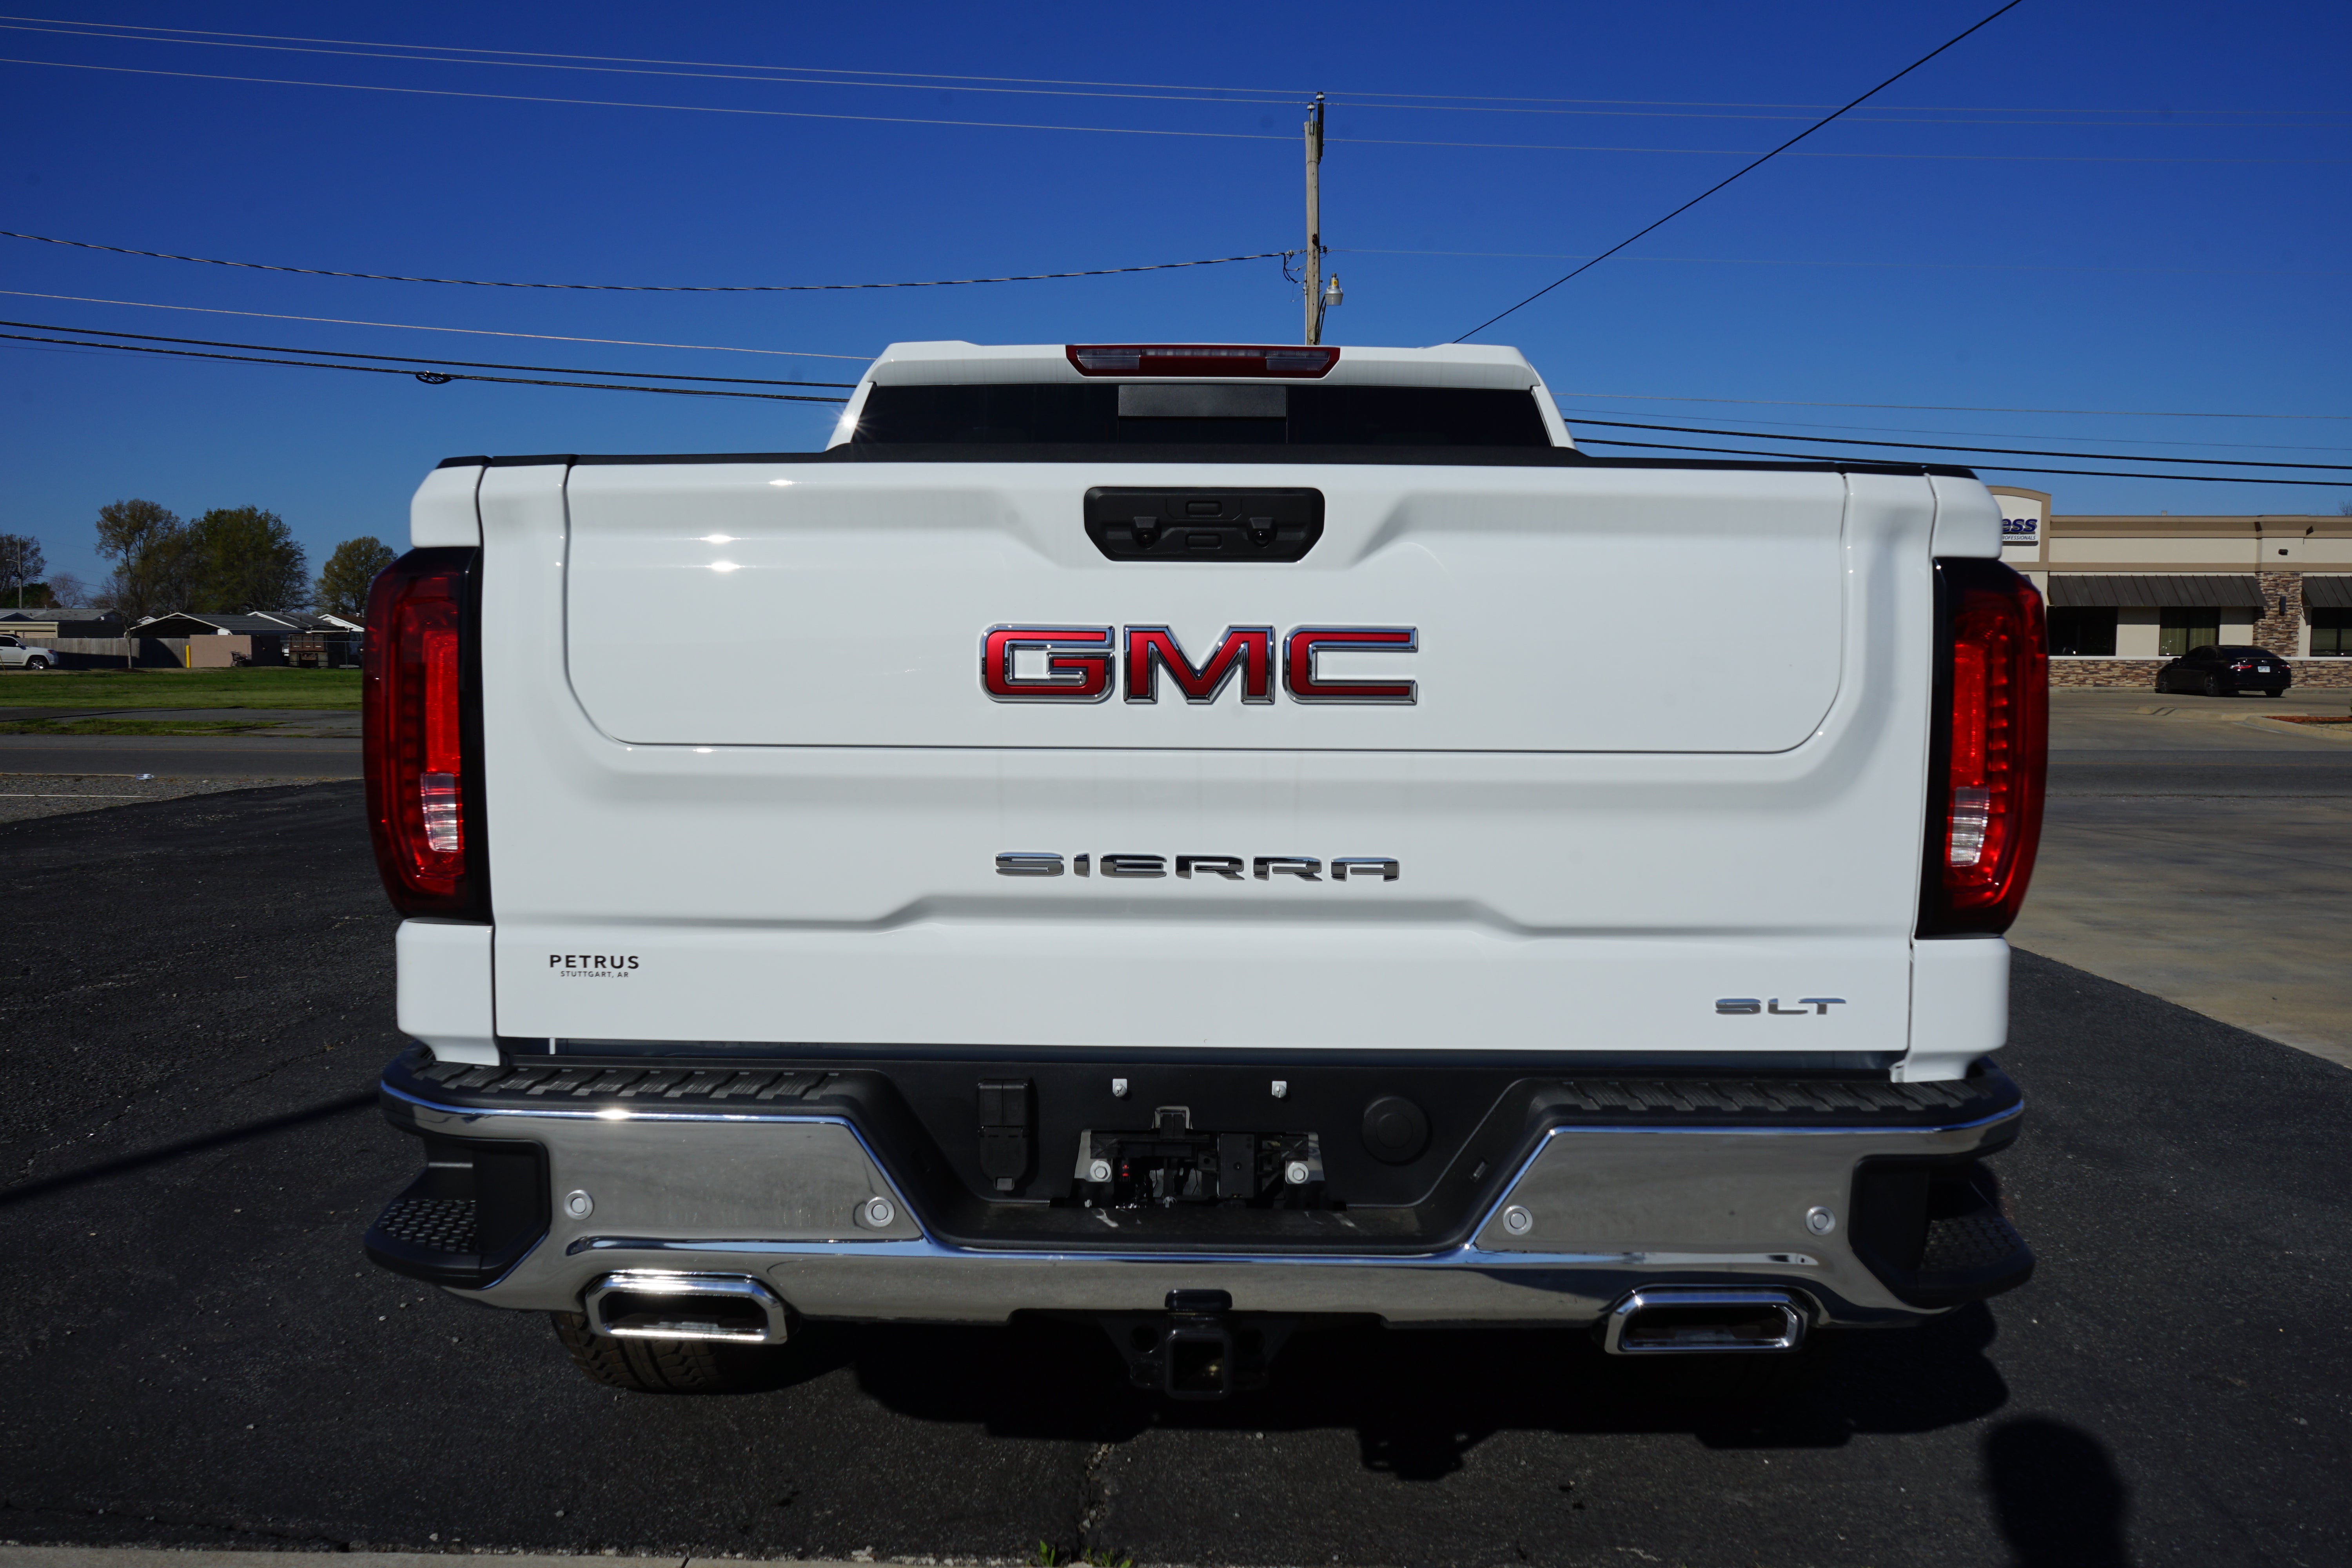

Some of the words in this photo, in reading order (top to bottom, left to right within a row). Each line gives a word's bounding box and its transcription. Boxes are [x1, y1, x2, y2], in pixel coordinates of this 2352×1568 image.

[2002, 519, 2038, 532] ess
[980, 624, 1418, 705] GMC
[995, 852, 1400, 882] SIERRA
[550, 955, 639, 969] PETRUS
[1715, 998, 1846, 1015] SLT
